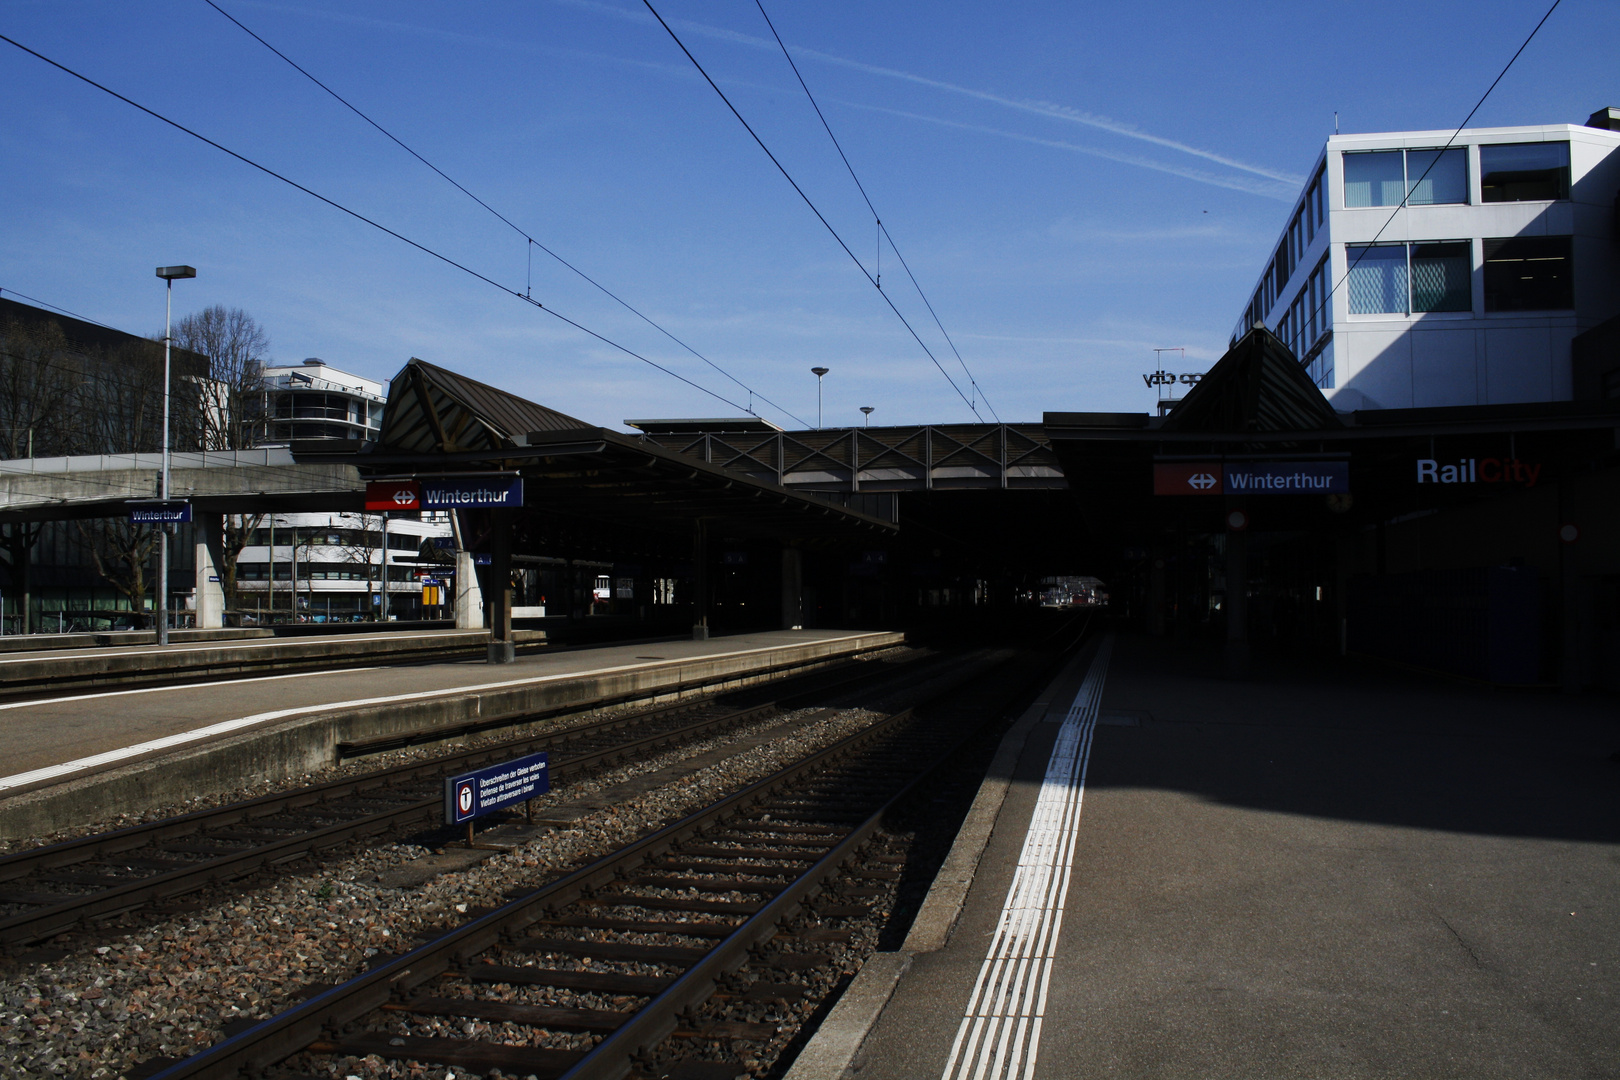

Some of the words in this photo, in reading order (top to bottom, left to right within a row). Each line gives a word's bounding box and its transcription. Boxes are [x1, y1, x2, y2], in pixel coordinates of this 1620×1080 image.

[1229, 473, 1334, 490] Winterthur
[1416, 458, 1542, 487] RailCity
[426, 489, 509, 504] Winterthur
[132, 510, 183, 521] Winterthur
[480, 773, 509, 788] Überschreiten
[517, 767, 529, 776] Gleise
[530, 762, 546, 772] verboten
[498, 784, 505, 792] de
[505, 778, 522, 789] traverser
[530, 773, 540, 782] voies
[480, 796, 496, 808] Vietato
[497, 789, 521, 802] attraversare
